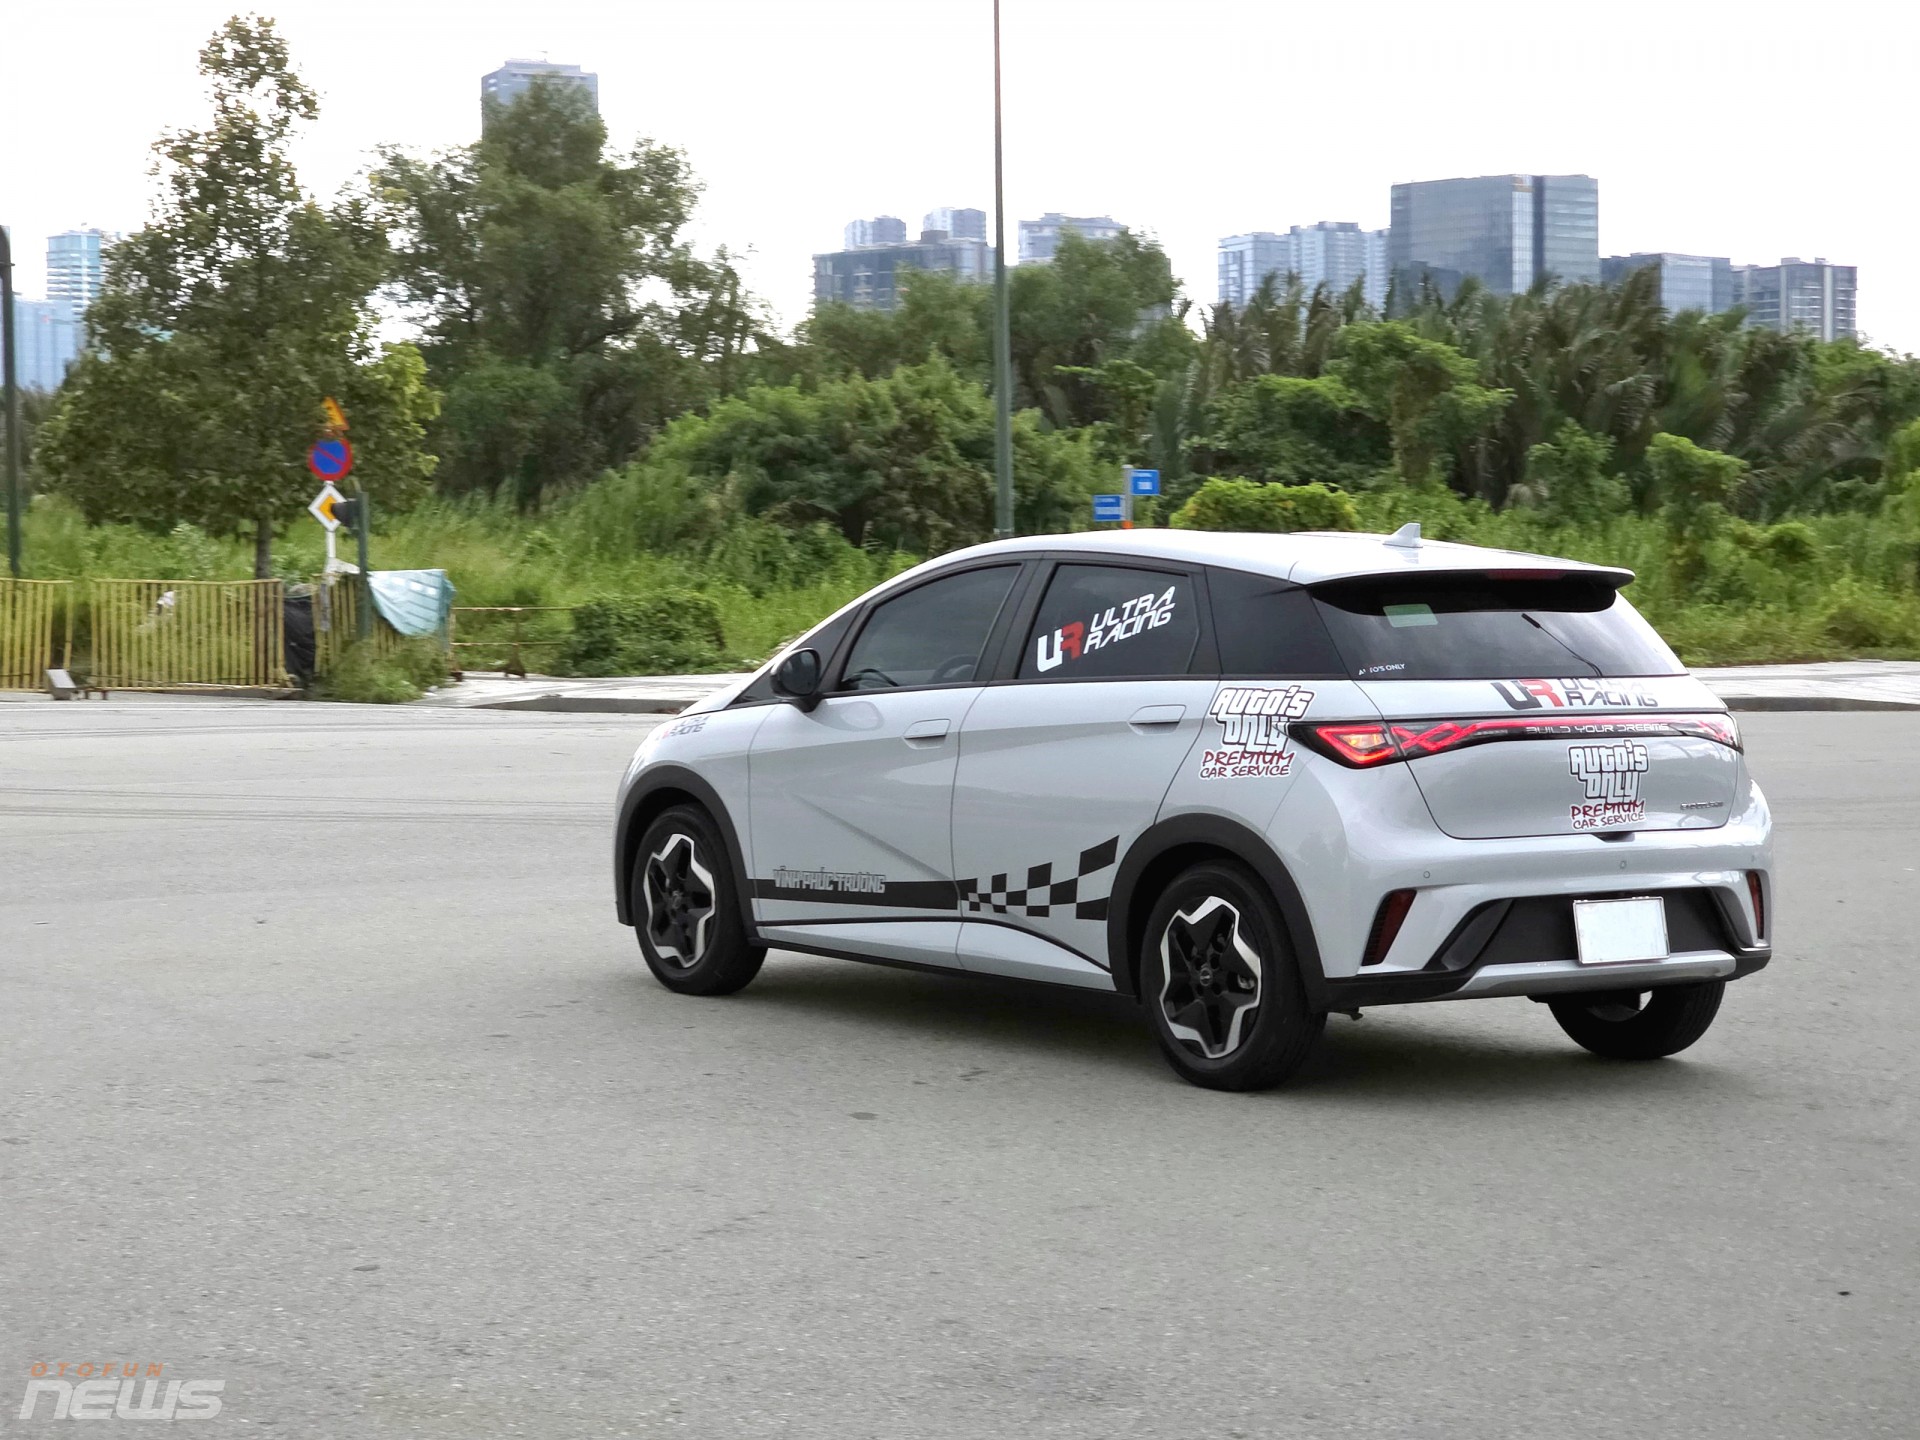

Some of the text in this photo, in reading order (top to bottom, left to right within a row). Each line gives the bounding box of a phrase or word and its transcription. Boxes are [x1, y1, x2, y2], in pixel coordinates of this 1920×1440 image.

[1090, 586, 1176, 632] ULTRA
[1083, 602, 1176, 654] RACING
[1037, 621, 1085, 672] UR
[1490, 679, 1565, 710] UR
[1563, 689, 1659, 708] RACING
[1525, 723, 1670, 734] BUILD YOUR DREAMS
[1202, 751, 1295, 767] PREMIUM
[1200, 764, 1290, 779] CAR SERVICE
[1571, 800, 1645, 820] PREMIUM
[1573, 813, 1645, 830] CAR SERVICE
